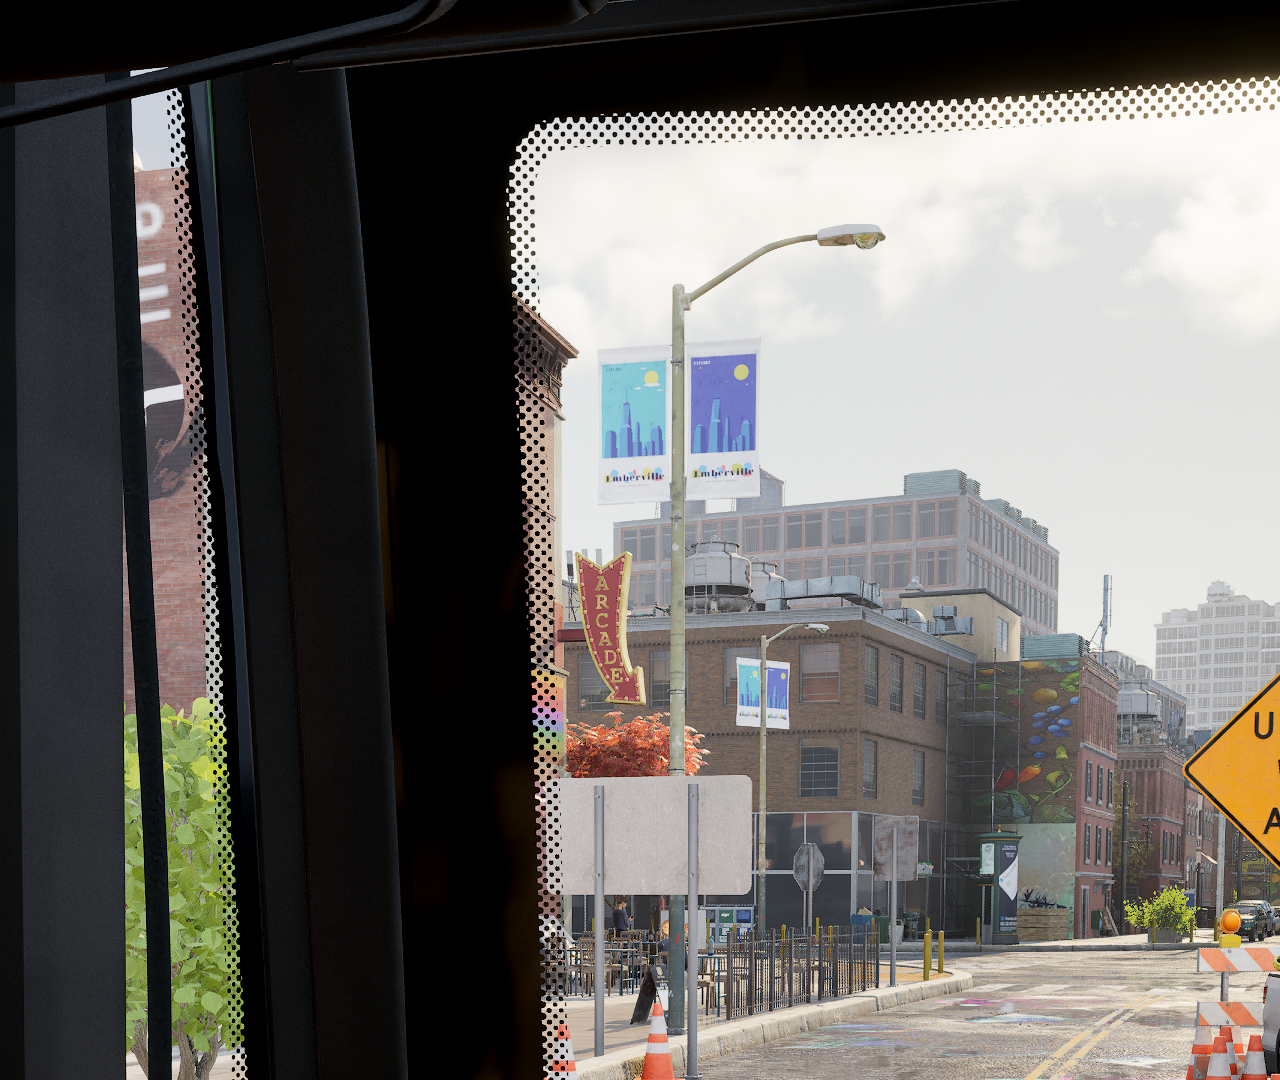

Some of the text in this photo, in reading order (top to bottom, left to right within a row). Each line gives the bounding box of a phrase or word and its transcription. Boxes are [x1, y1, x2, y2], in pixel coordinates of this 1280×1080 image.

[606, 472, 665, 483] Emberville
[694, 467, 754, 478] Emberville
[594, 575, 624, 683] ARCADE
